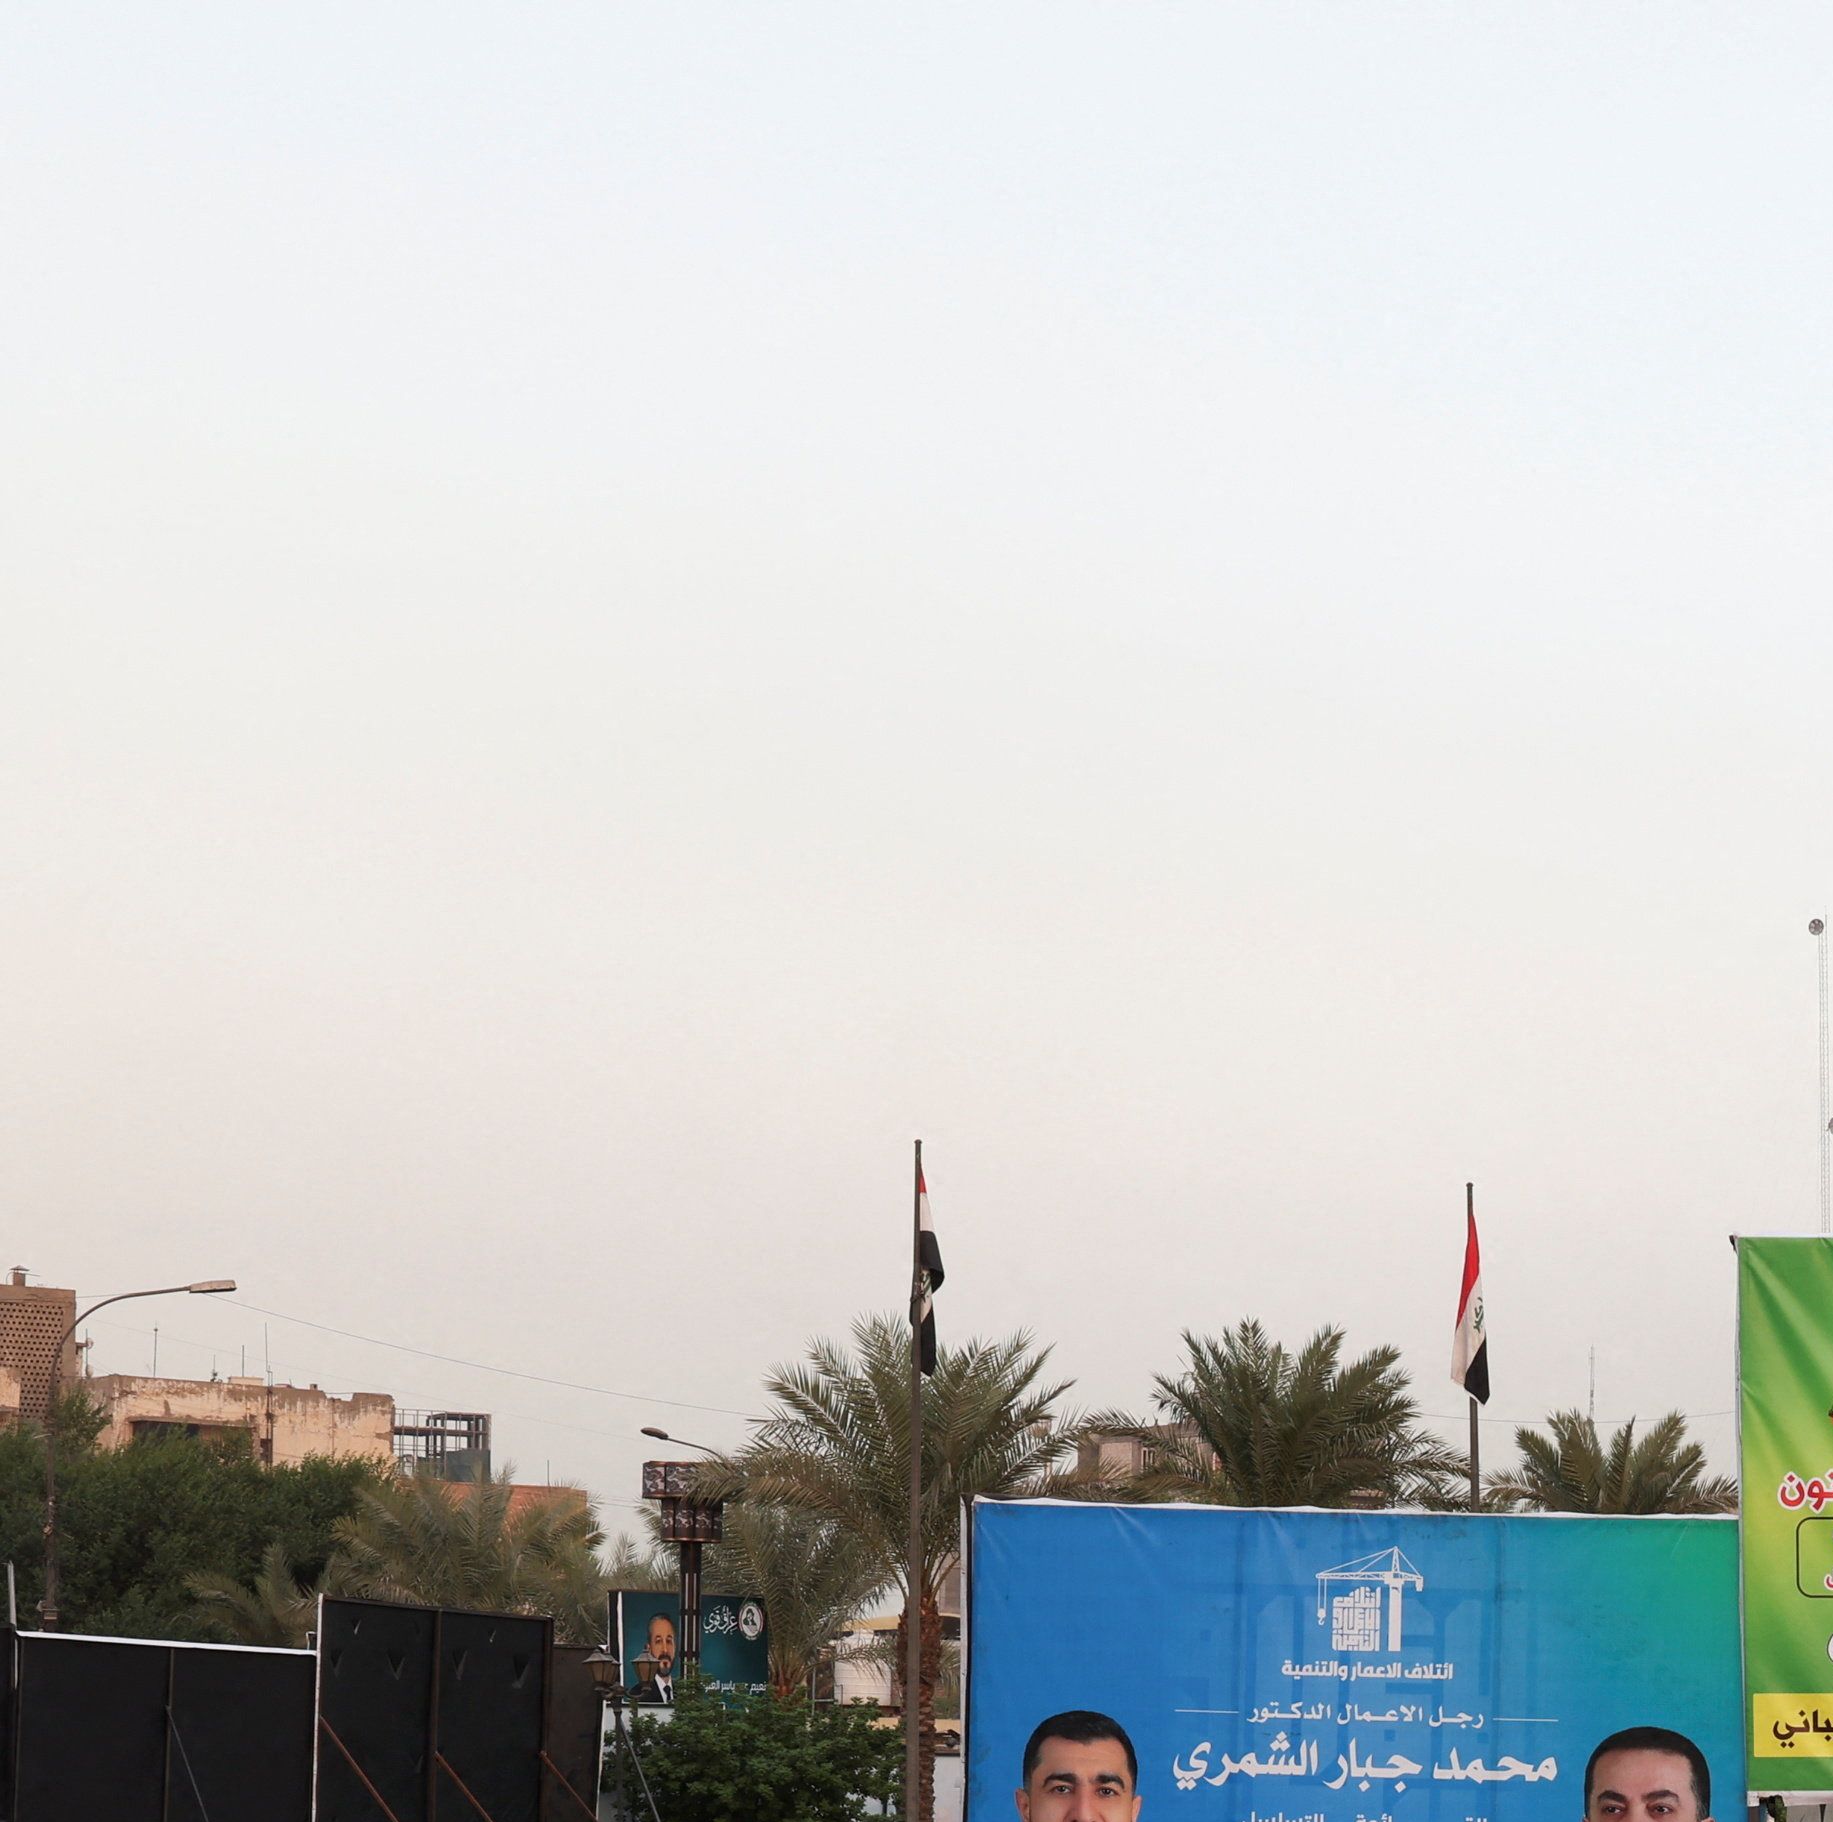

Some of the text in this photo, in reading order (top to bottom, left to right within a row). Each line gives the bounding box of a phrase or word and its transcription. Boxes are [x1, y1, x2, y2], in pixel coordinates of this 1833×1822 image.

[1281, 1659, 1349, 1681] والتنمية
[1404, 1663, 1454, 1680] ائتلاف
[1247, 1701, 1331, 1723] الدكتور
[1337, 1705, 1424, 1726] الاعمال
[1173, 1730, 1558, 1793] محمد جبار الشمري
